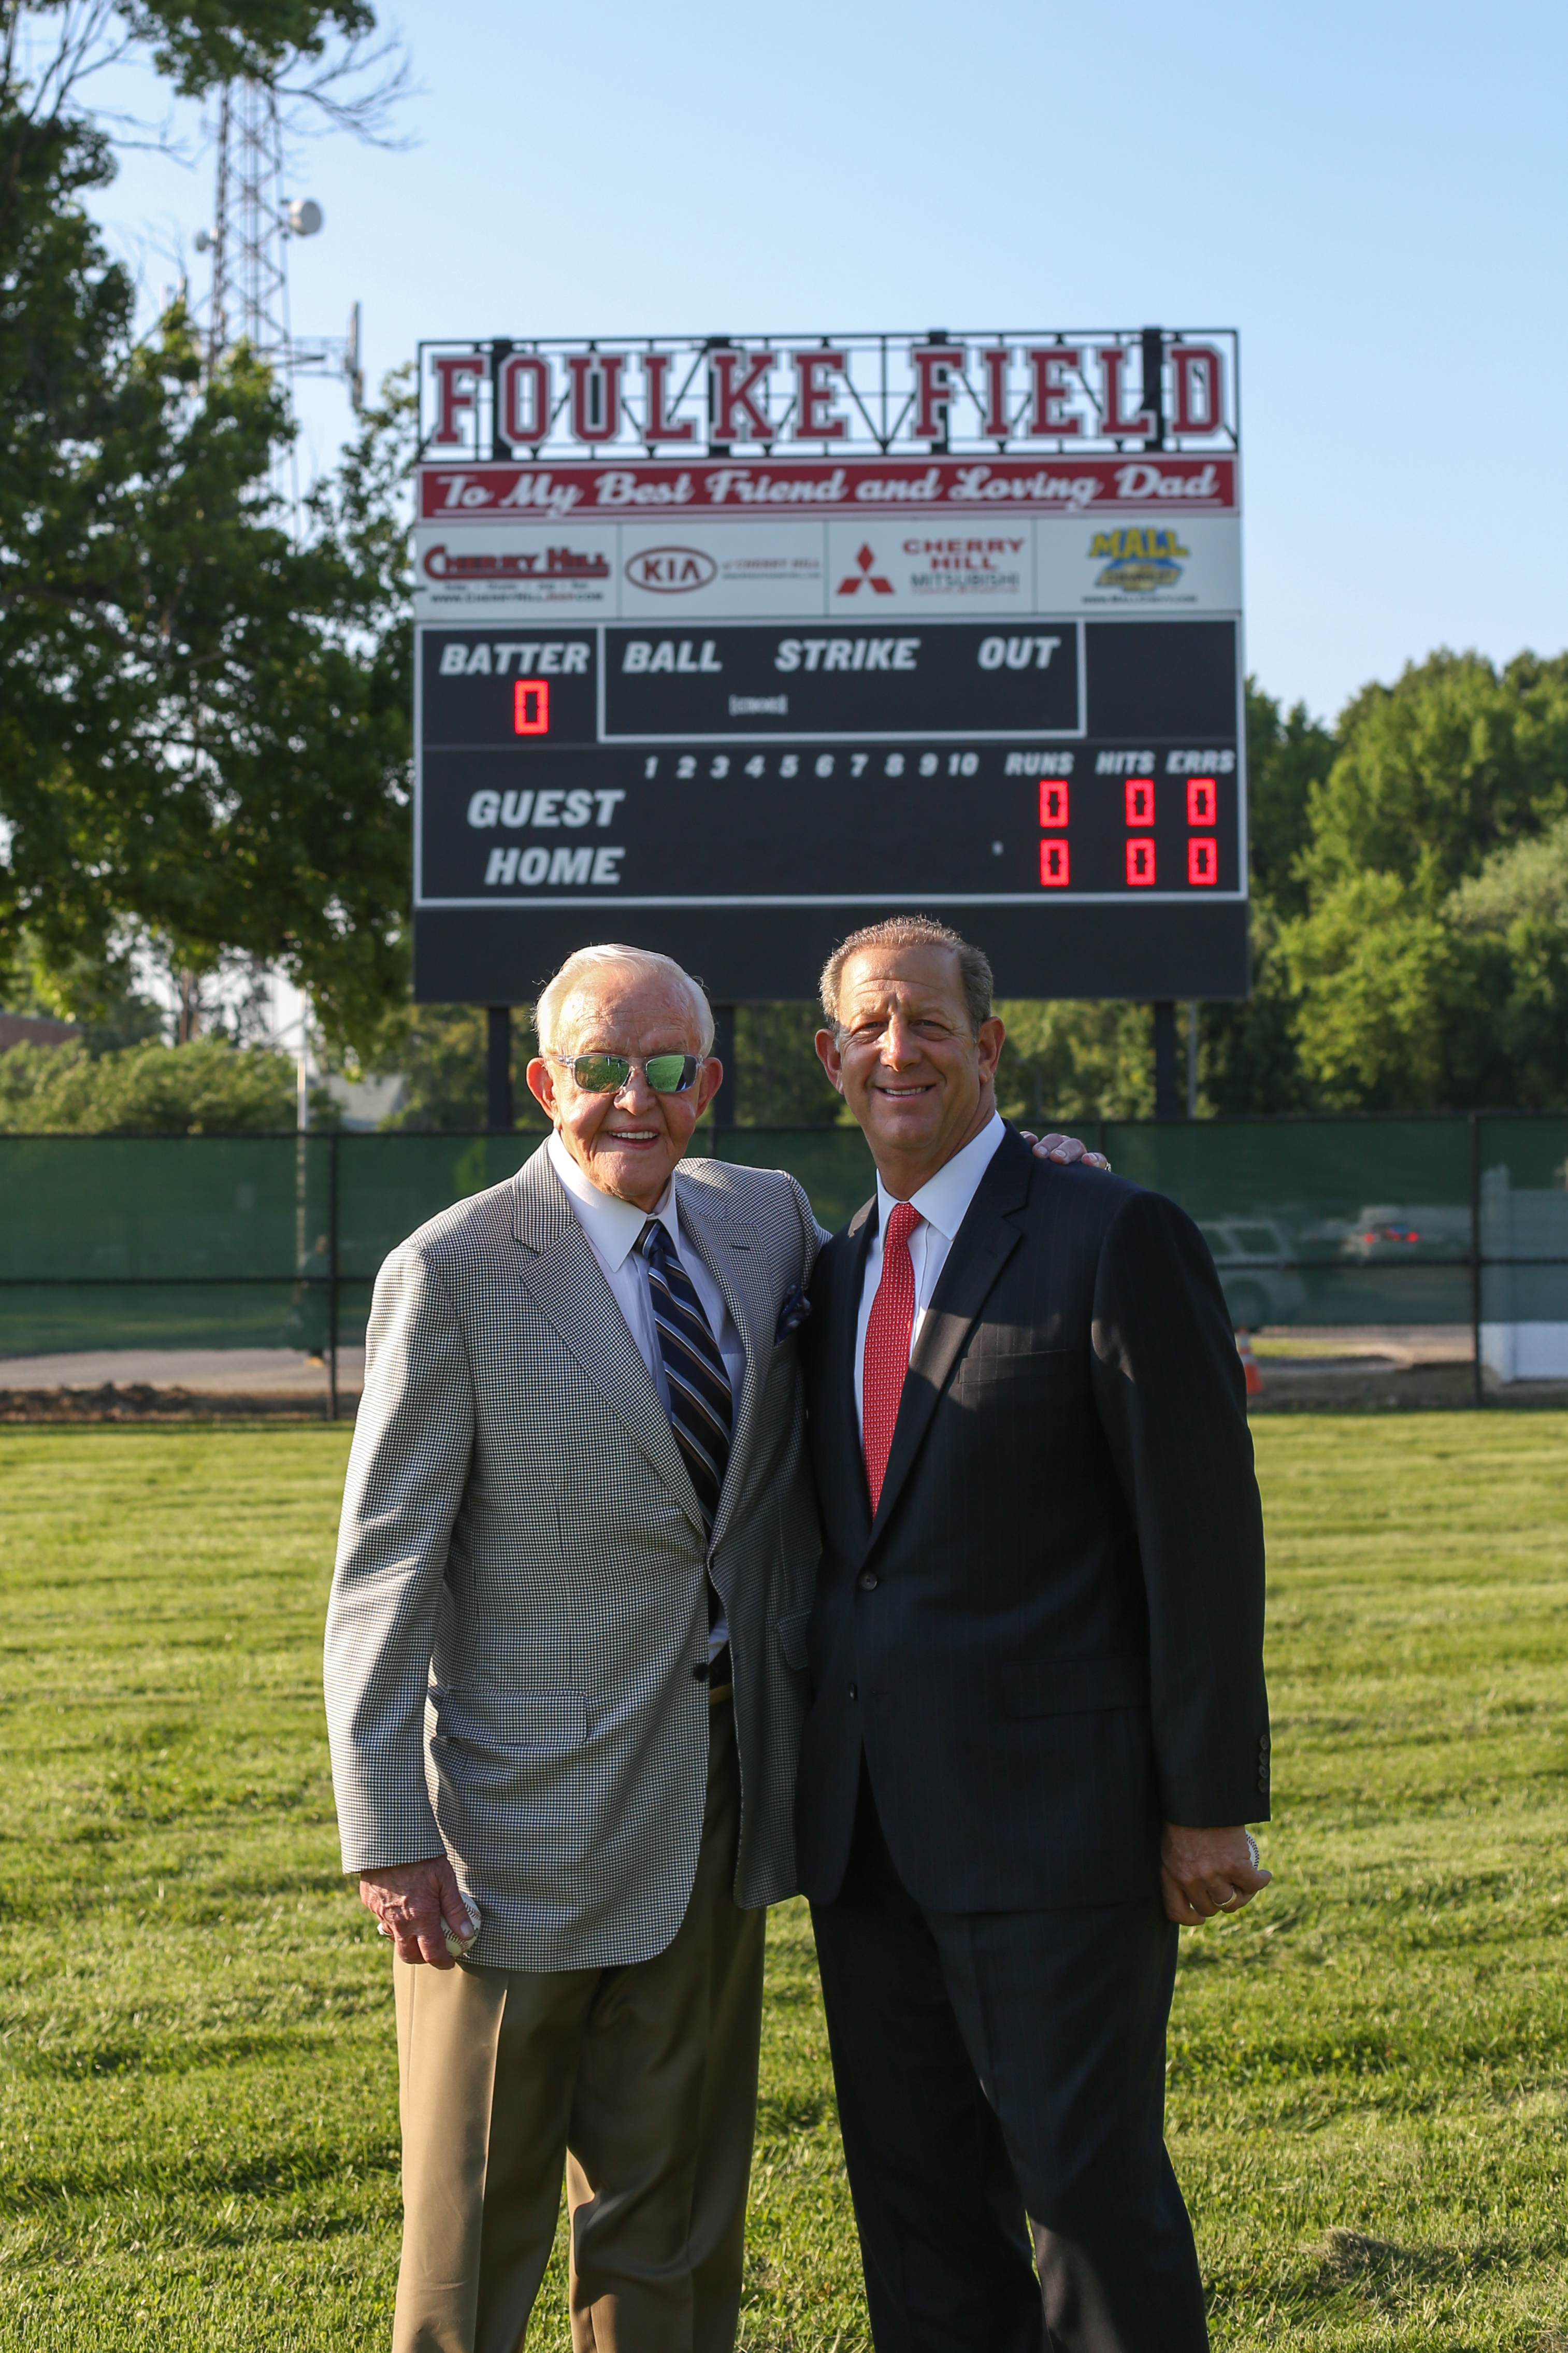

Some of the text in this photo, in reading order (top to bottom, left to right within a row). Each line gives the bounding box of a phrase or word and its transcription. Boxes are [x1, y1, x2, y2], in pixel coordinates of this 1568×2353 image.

[432, 345, 1225, 446] FOULKE FIELD
[436, 463, 1221, 518] To My Best Friend and Loving Dad
[902, 536, 1026, 554] CHERRY
[1089, 526, 1190, 558] MALL
[643, 558, 700, 582] KIA
[911, 573, 1020, 587] MITSUBISHI
[930, 555, 998, 572] HILL
[439, 642, 591, 676] BATTER
[622, 636, 1061, 673] BALL STRIKE OUT
[514, 679, 549, 734] 0
[644, 749, 1236, 779] 1 2 3 4 5 6 7 8 9 10 RUNS HITS ERRS
[467, 789, 626, 829] GUEST
[1039, 778, 1217, 828] 0 0 0
[484, 847, 625, 886] HOME
[1040, 837, 1217, 887] 0 0 0
